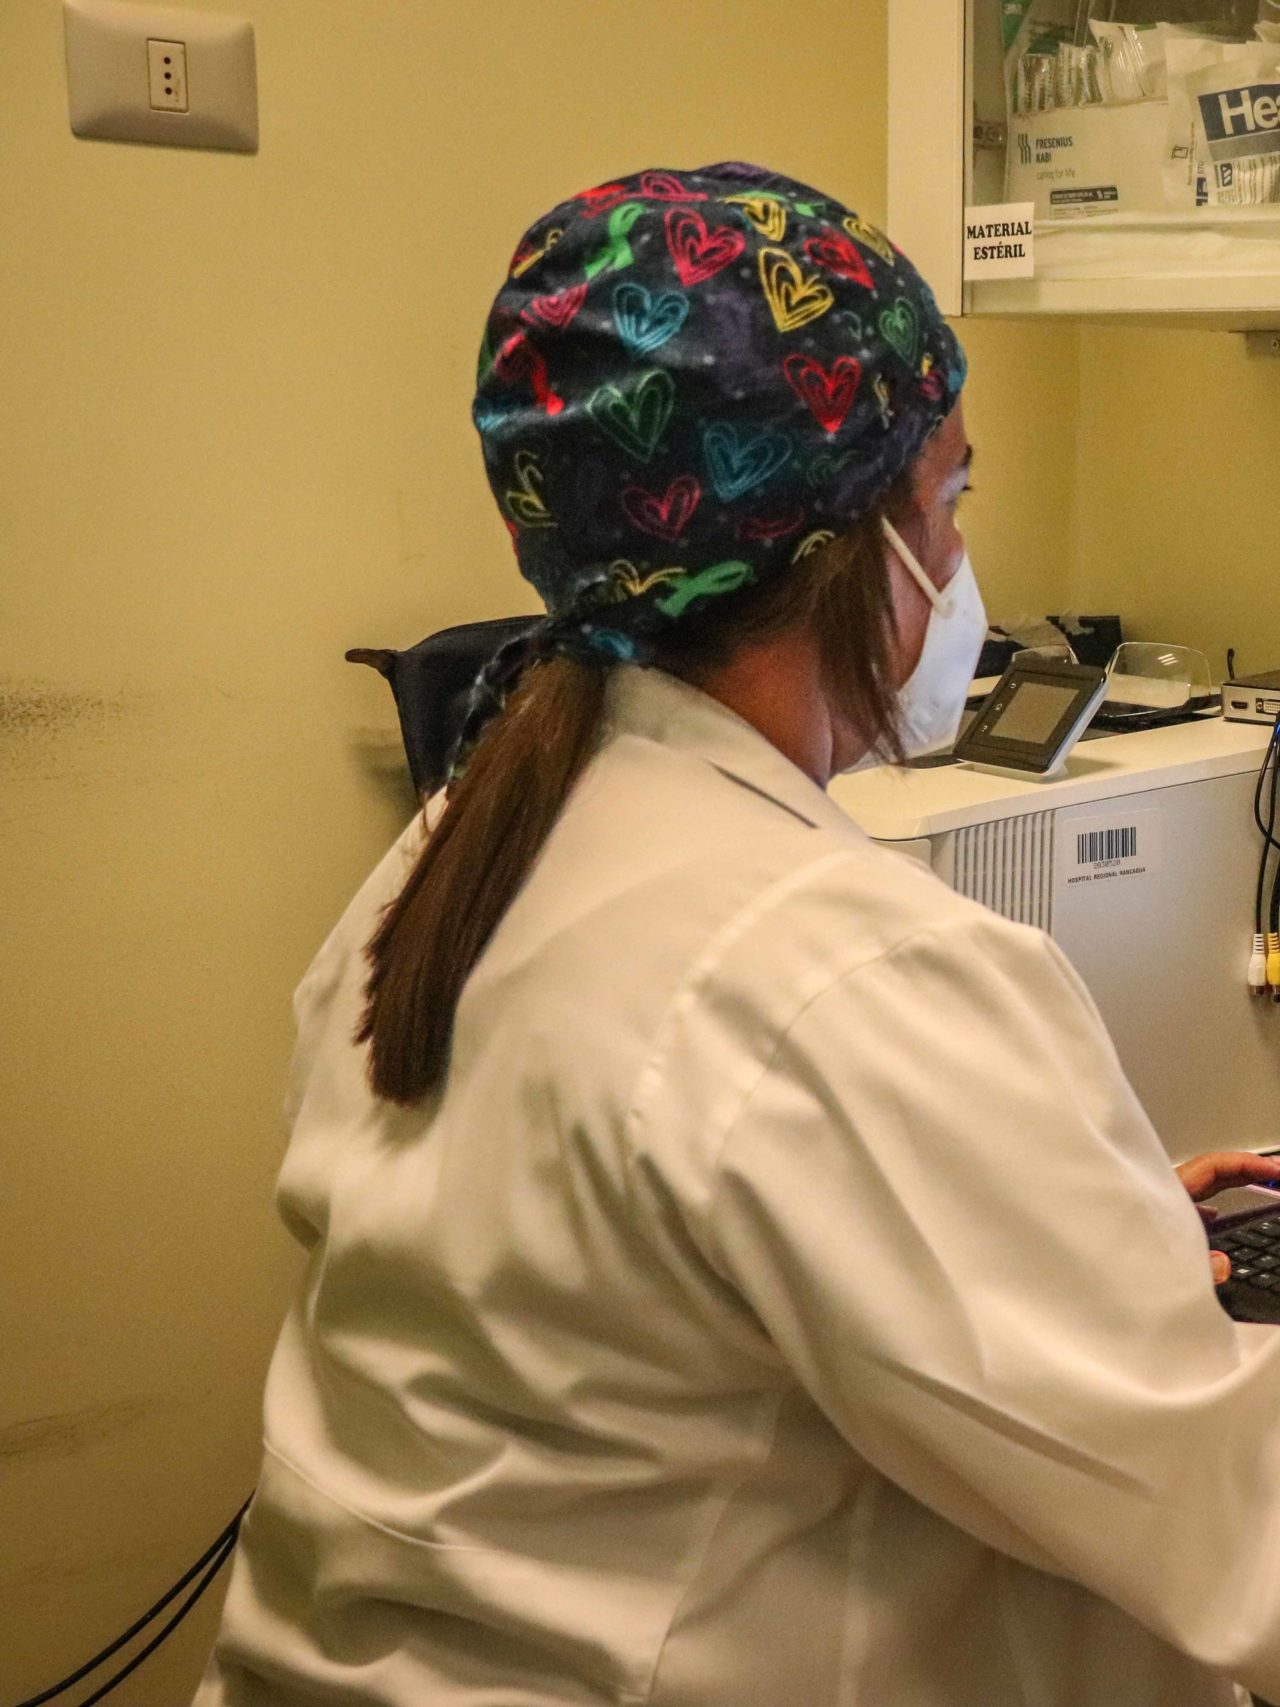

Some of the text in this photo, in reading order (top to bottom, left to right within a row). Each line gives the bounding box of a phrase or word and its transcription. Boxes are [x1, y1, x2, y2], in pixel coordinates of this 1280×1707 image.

[1036, 136, 1073, 149] FRESENIUS
[1036, 152, 1052, 164] KABI
[967, 221, 1032, 239] MATERIAL
[973, 241, 1026, 260] ESTÉRIL
[1067, 866, 1146, 884] HOSPITAL REGIONAL RANCAGUA
